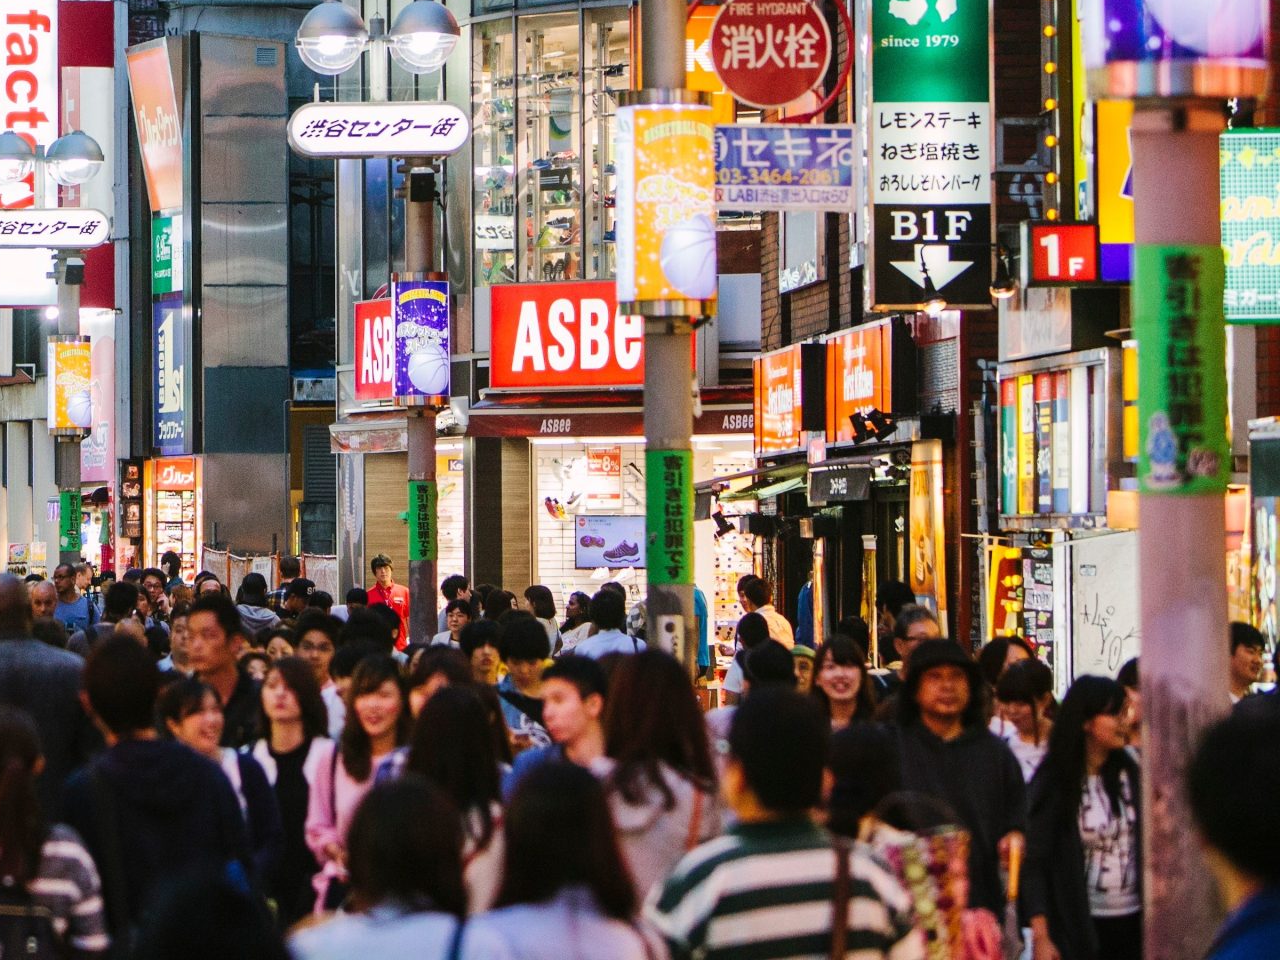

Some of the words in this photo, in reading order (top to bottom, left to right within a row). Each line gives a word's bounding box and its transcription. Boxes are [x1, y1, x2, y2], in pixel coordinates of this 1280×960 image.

[730, 3, 754, 16] FIRE
[757, 3, 807, 16] HYDRANT
[721, 23, 820, 69] 消火栓
[882, 36, 919, 48] since
[925, 35, 960, 48] 1979
[300, 117, 459, 139] 渋谷センター街
[880, 112, 982, 129] レモンステーキ
[881, 143, 980, 161] ねぎ塩焼き
[880, 174, 982, 191] おろししそハンバーグ
[890, 210, 972, 241] B1F
[1040, 233, 1084, 277] 1F
[540, 418, 571, 433] ASBee
[722, 414, 753, 430] ASBee
[163, 465, 194, 485] グルメ
